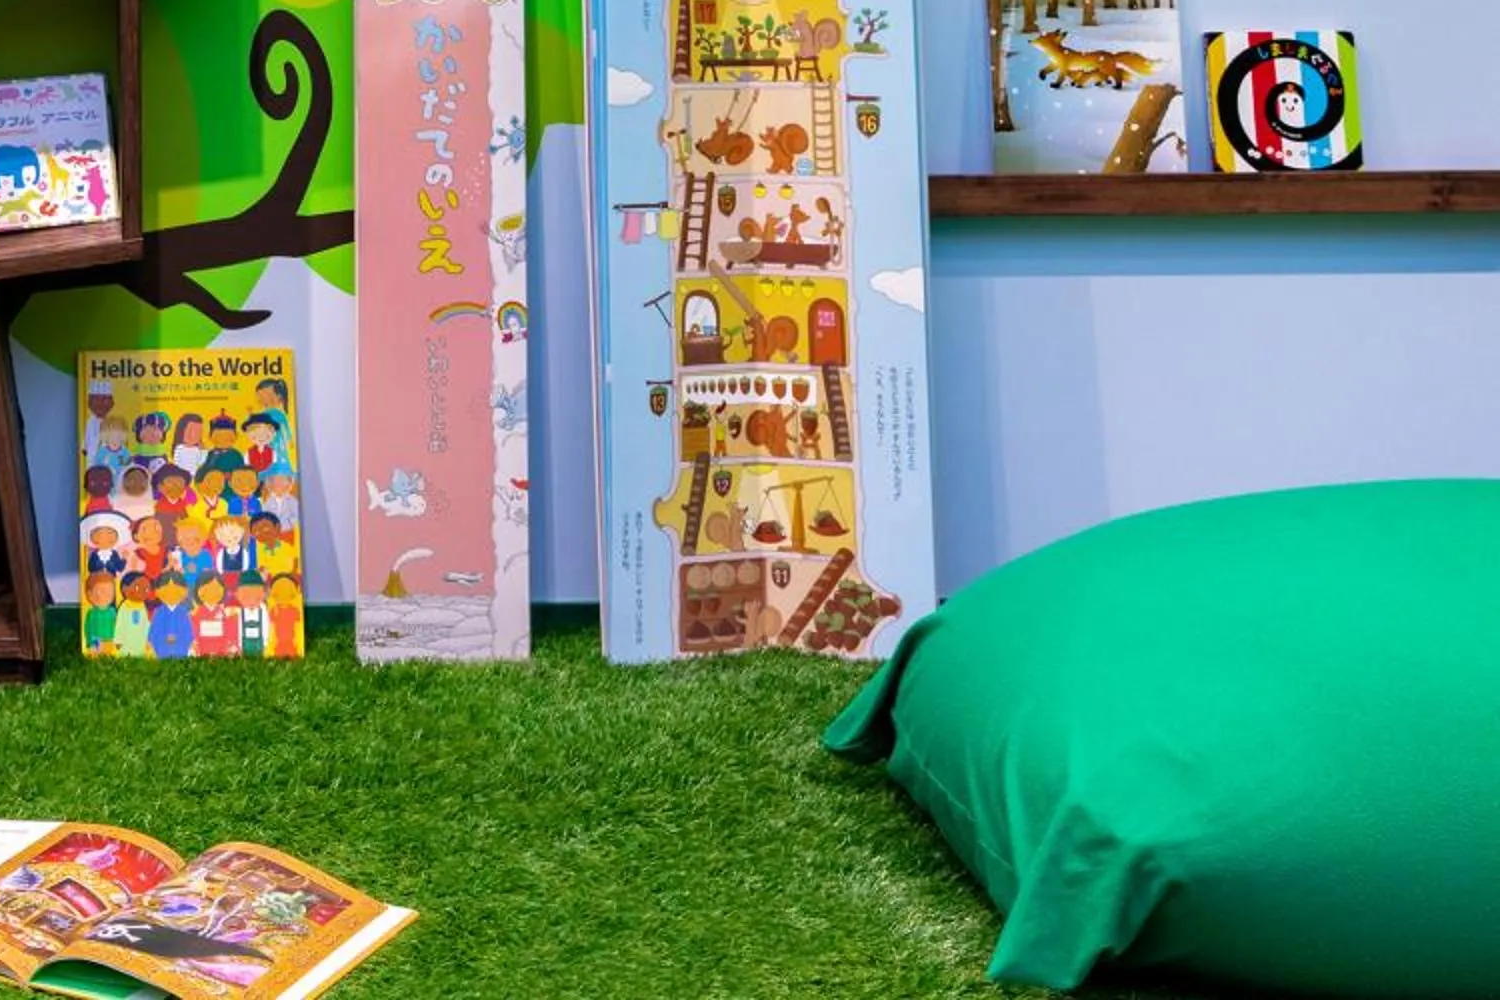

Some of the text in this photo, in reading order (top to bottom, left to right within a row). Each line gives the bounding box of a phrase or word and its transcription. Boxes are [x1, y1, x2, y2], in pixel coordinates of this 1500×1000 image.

[41, 108, 100, 124] アニマル
[859, 115, 878, 133] 16
[413, 13, 467, 276] かいだてのいえ
[91, 356, 283, 378] Hello to the World
